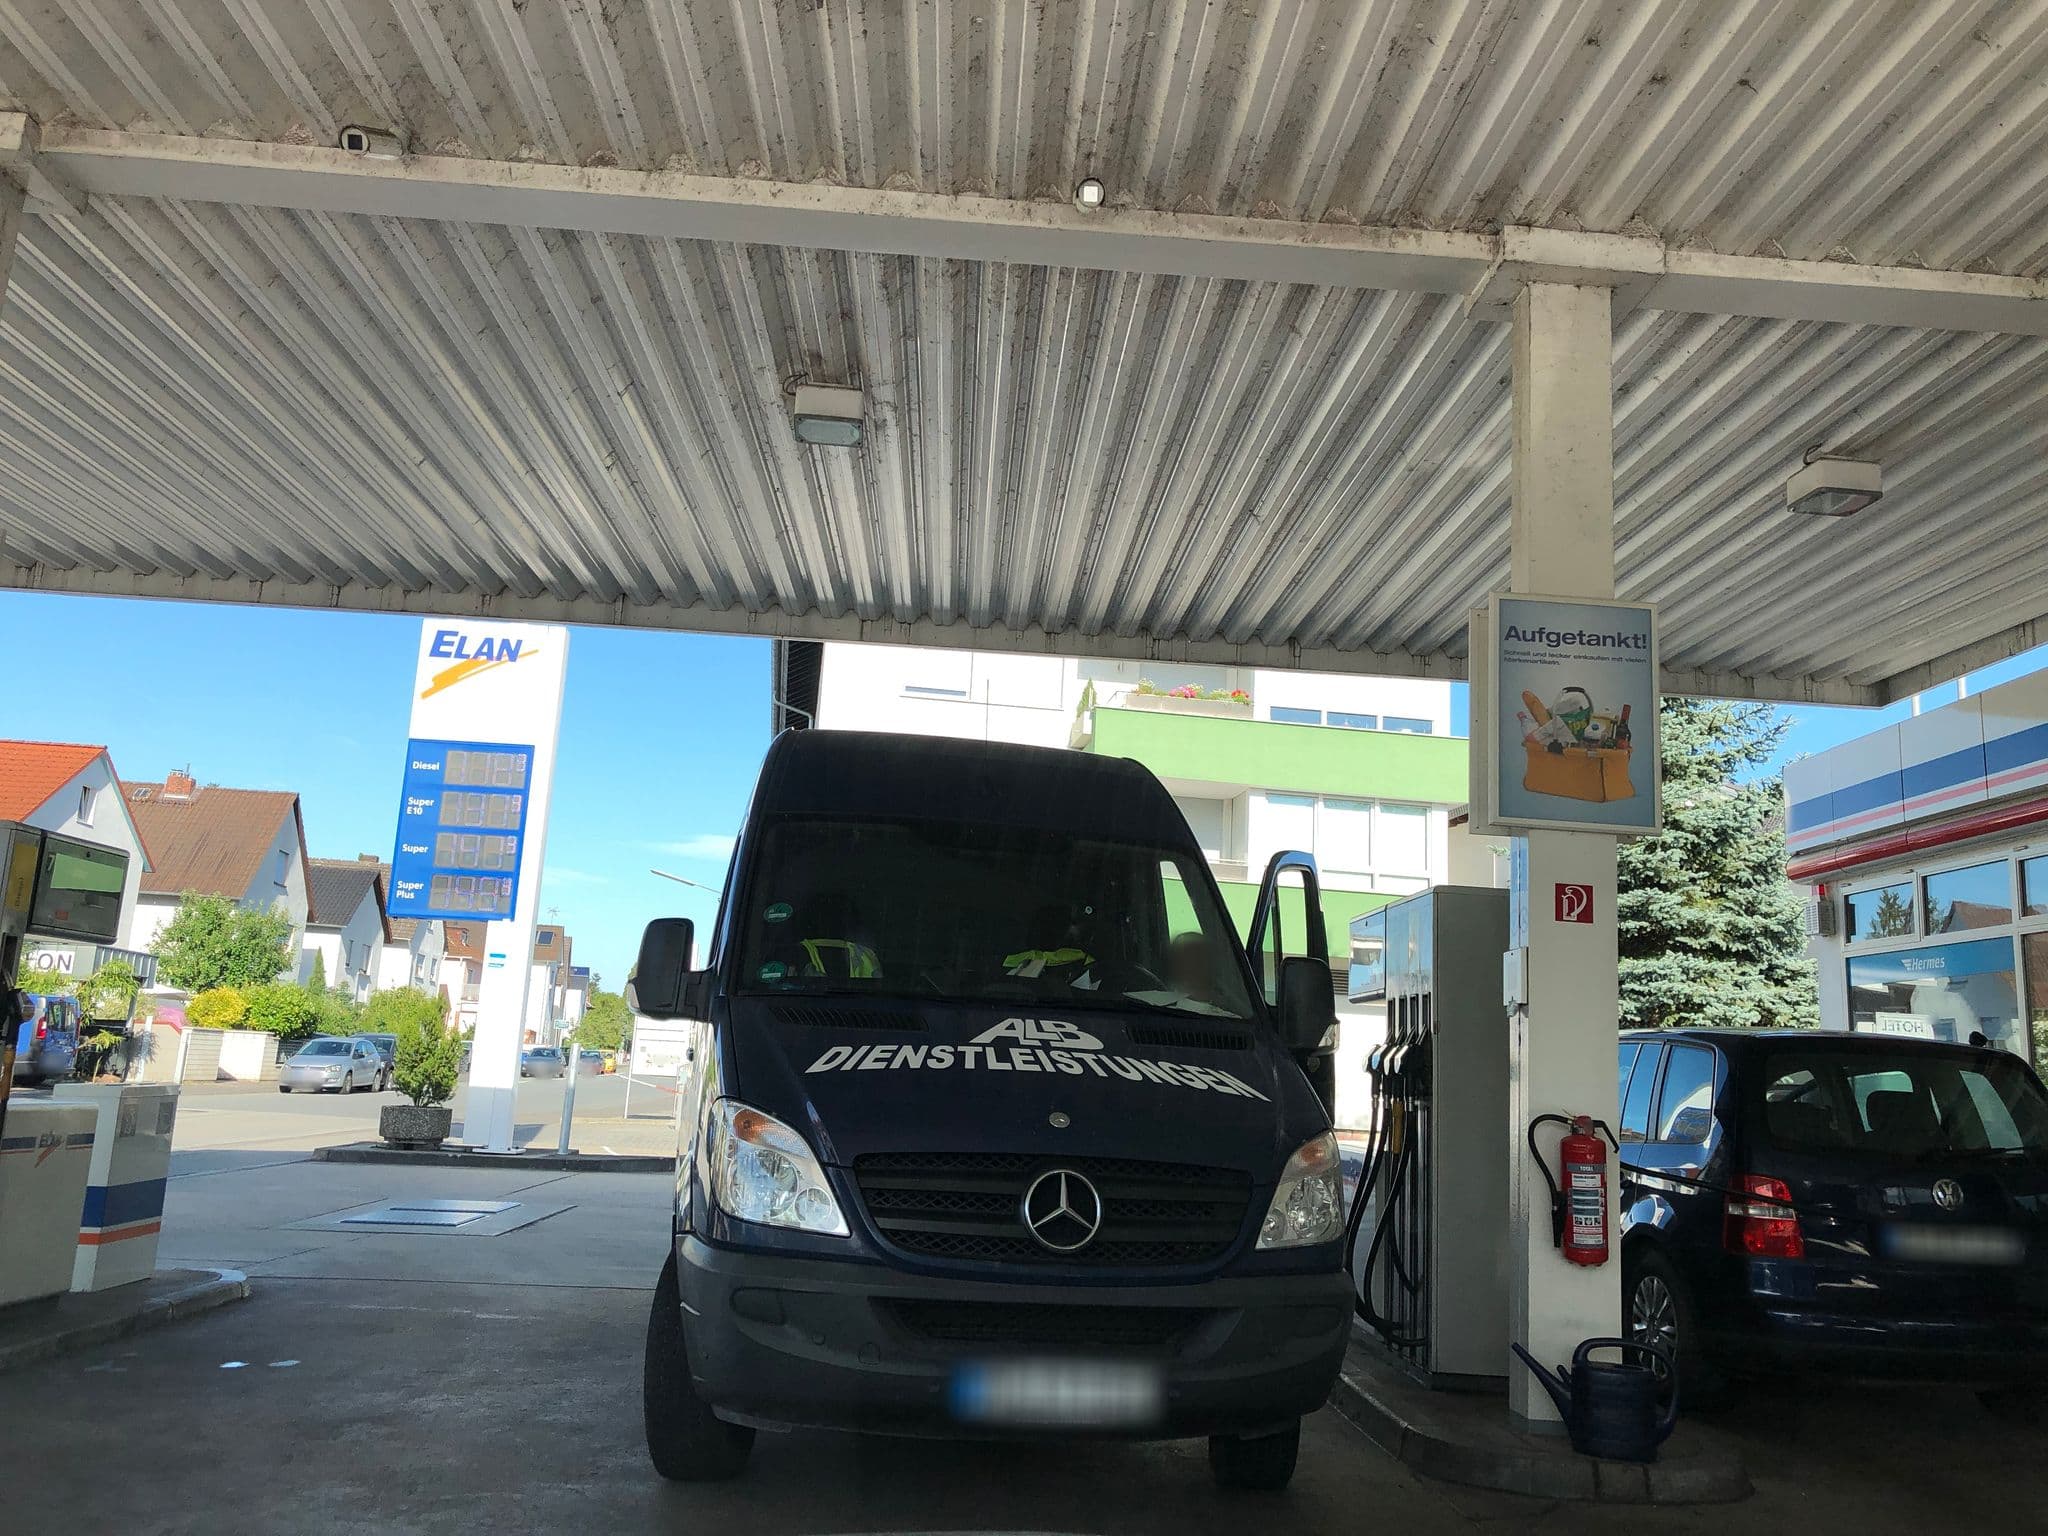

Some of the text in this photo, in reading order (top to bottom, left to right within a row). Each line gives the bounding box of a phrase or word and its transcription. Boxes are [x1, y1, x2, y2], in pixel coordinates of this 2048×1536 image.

[1504, 625, 1648, 649] Aufgetankt!
[429, 629, 523, 662] ELAN
[412, 761, 440, 771] Diesel
[407, 797, 434, 807] Super
[407, 807, 423, 816] E10
[402, 843, 428, 854] Super
[397, 880, 424, 891] Super
[396, 890, 415, 900] Plus
[1912, 956, 1945, 971] Hermes
[969, 1018, 1104, 1050] ALB
[804, 1045, 1272, 1102] DIENSTLEISTUNGEN
